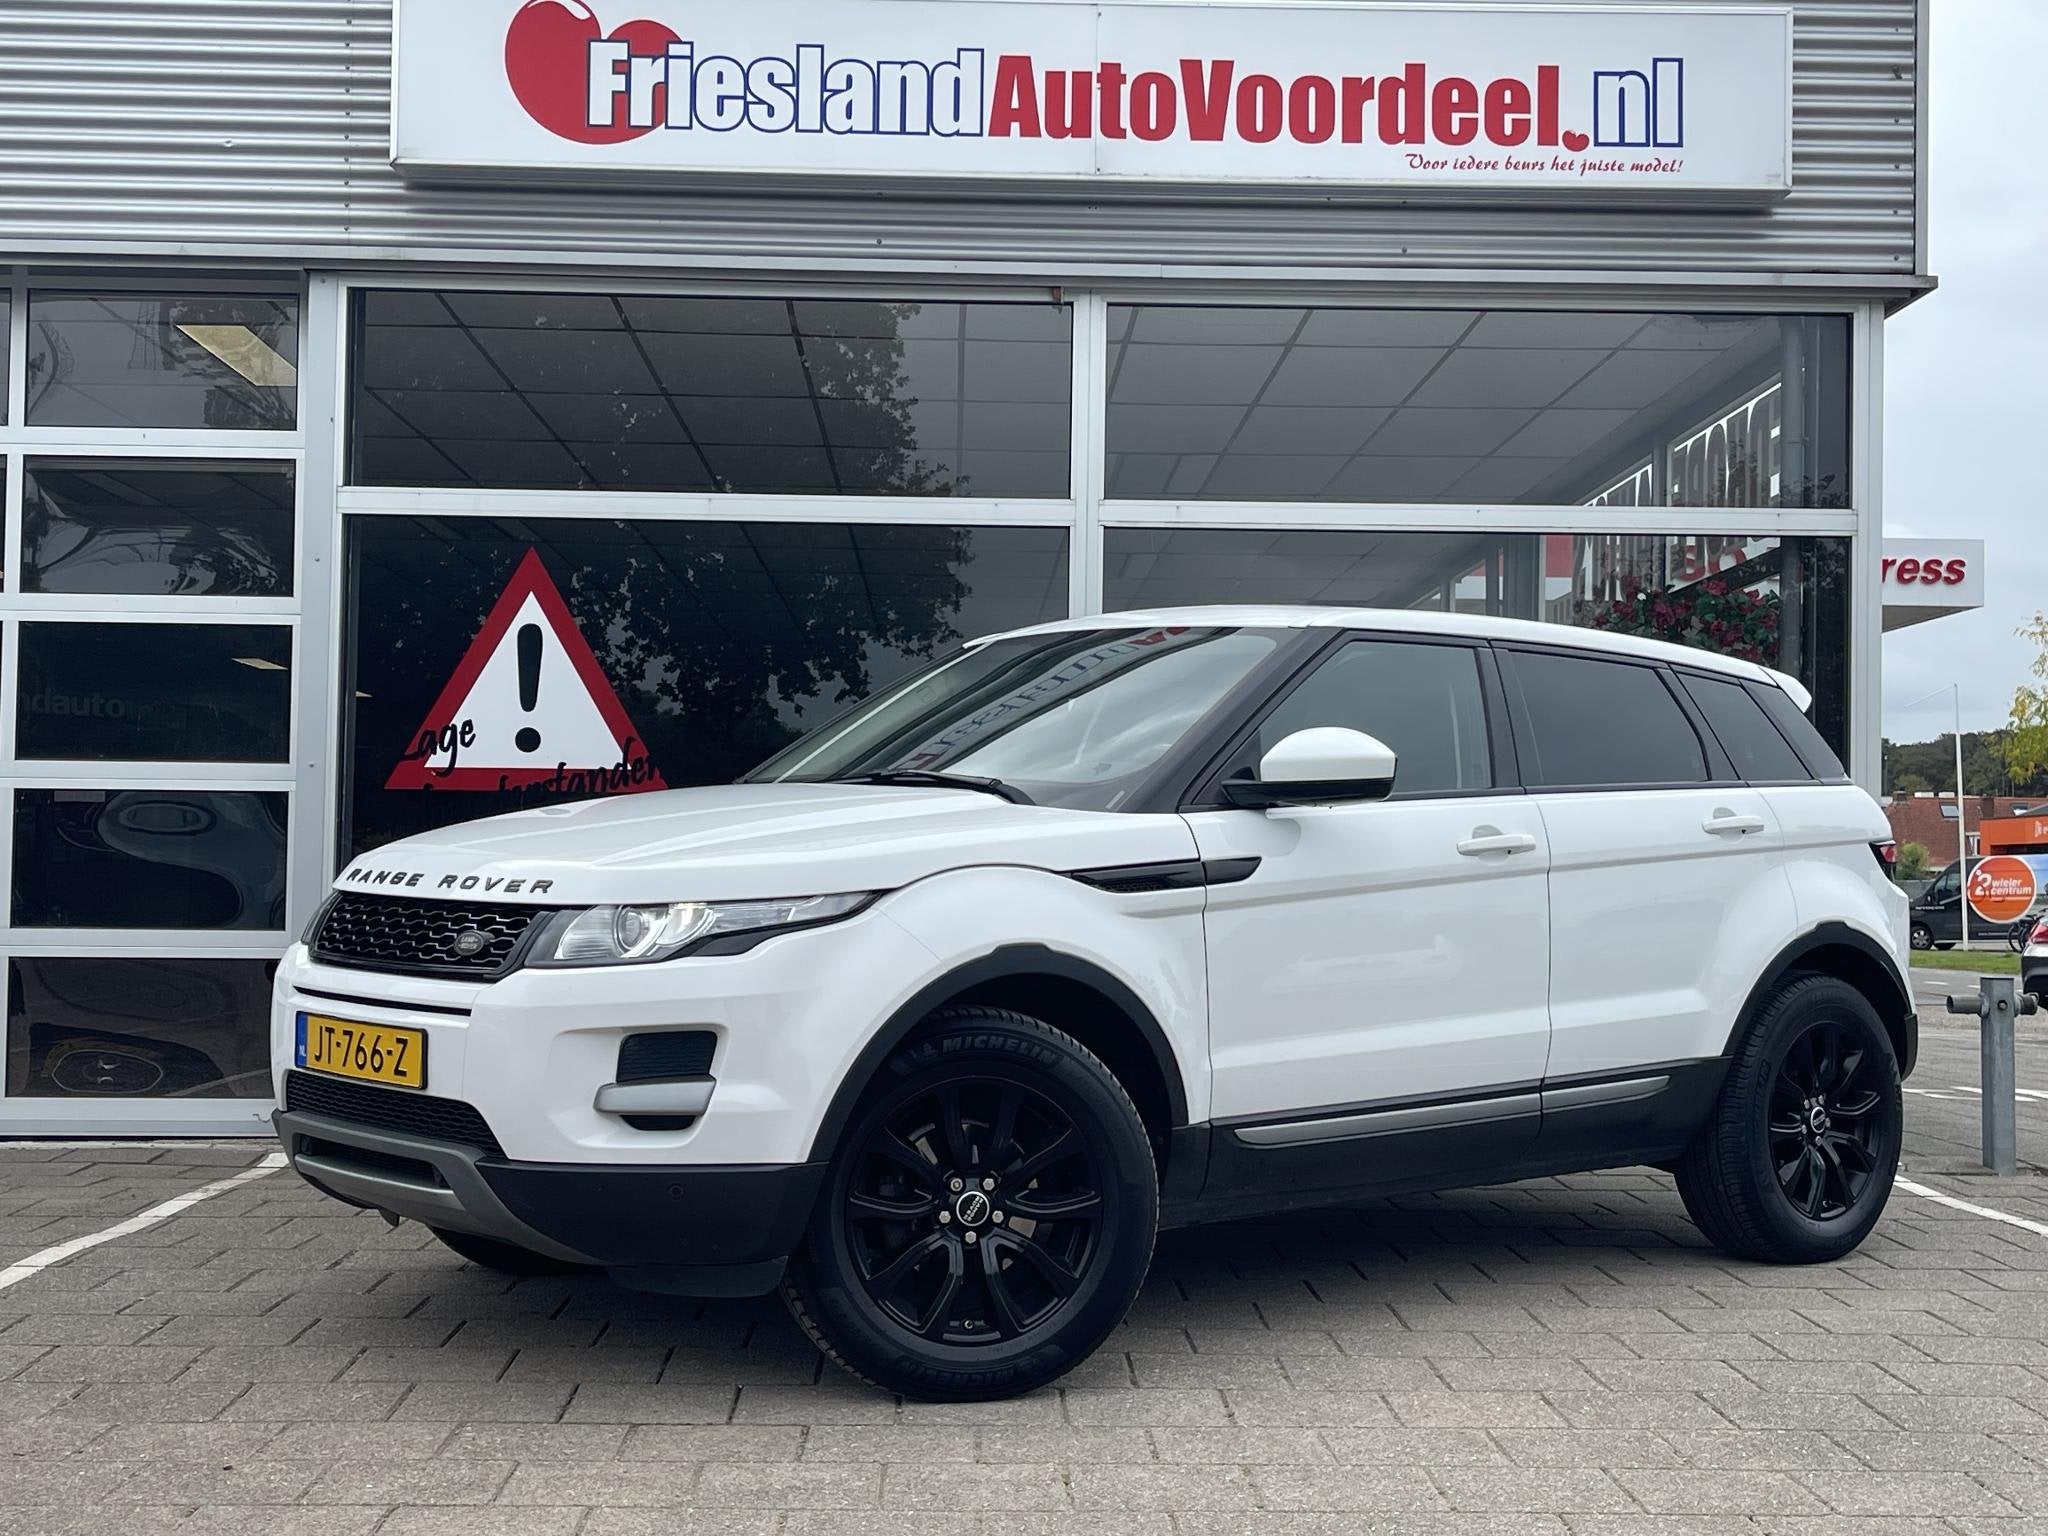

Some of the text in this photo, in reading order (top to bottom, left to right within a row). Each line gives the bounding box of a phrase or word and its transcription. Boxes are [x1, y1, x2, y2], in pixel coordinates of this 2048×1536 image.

[1405, 153, 1684, 177] Voor iedere beurs het juiste model!
[346, 868, 554, 894] RANGE ROVER
[1990, 886, 2032, 895] centrum
[314, 1025, 409, 1077] JT-766-Z
[942, 1035, 1061, 1067] MICHELIN
